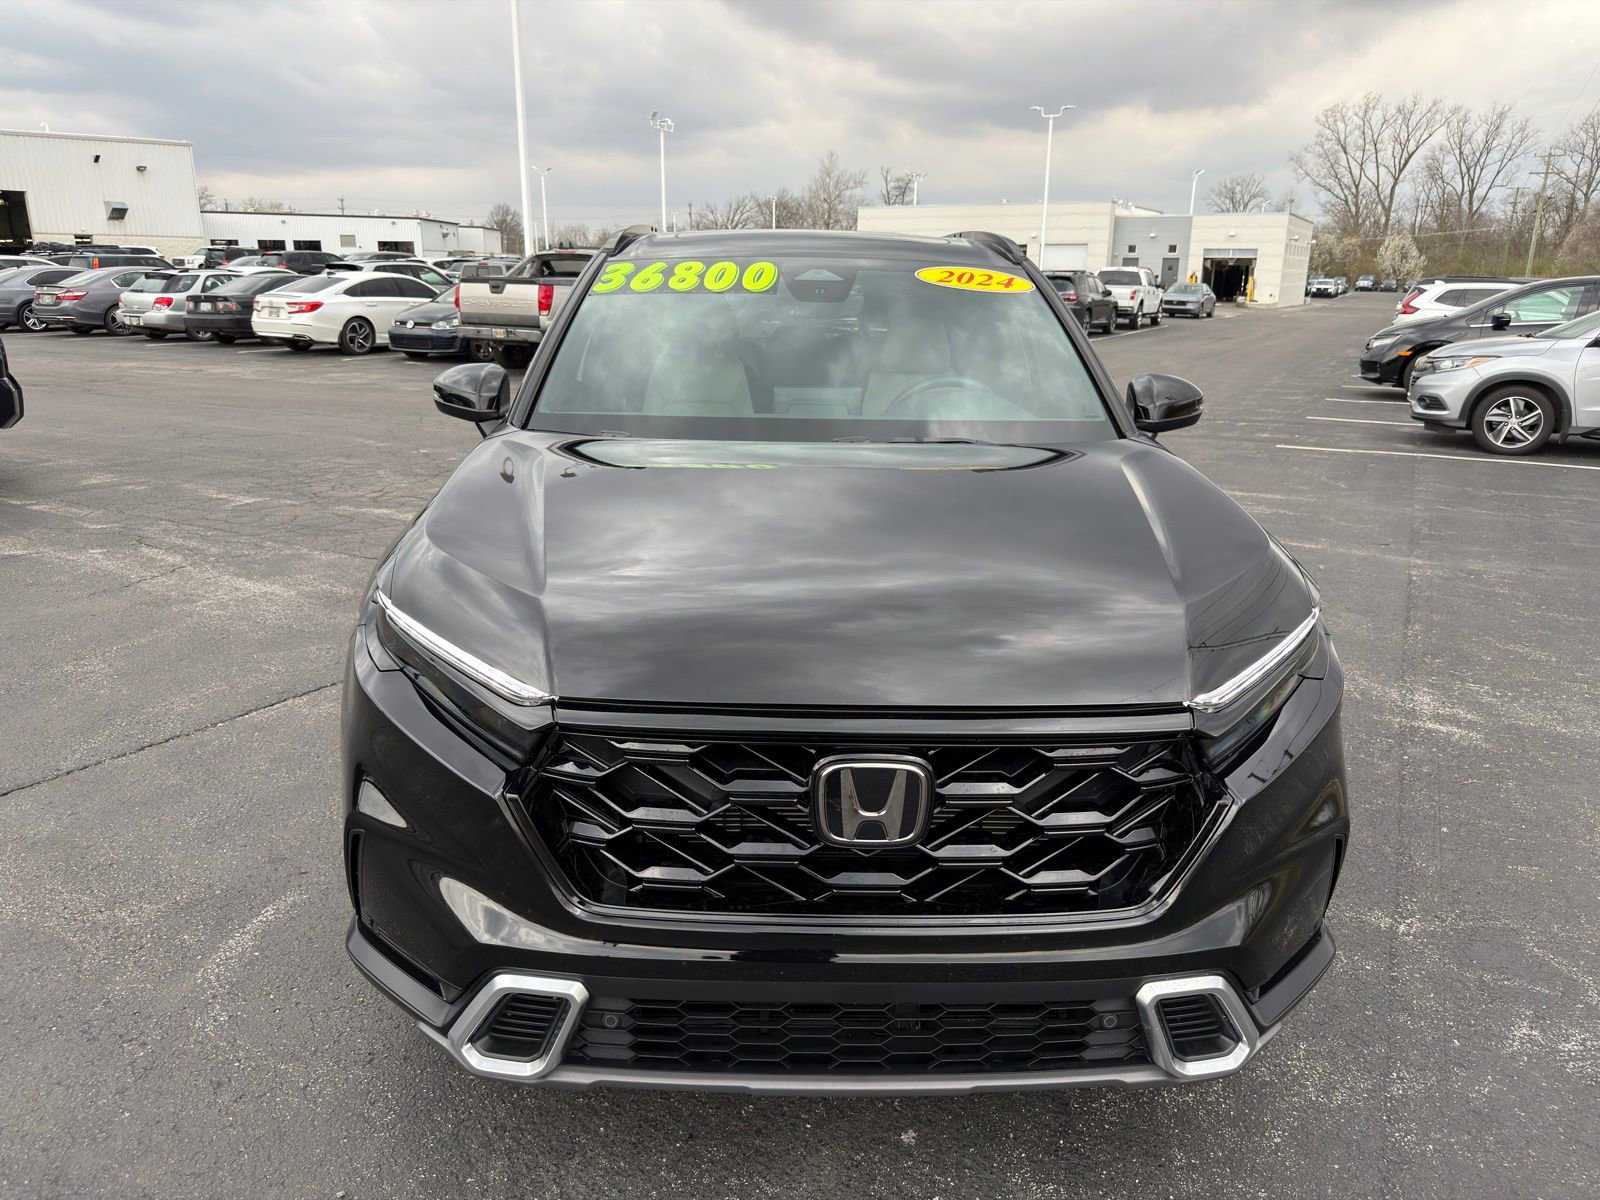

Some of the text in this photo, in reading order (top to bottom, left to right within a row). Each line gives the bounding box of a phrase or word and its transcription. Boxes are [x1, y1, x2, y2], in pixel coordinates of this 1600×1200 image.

[592, 261, 778, 292] 36800
[936, 270, 1015, 288] 2024
[463, 296, 535, 309] CHEVROLET
